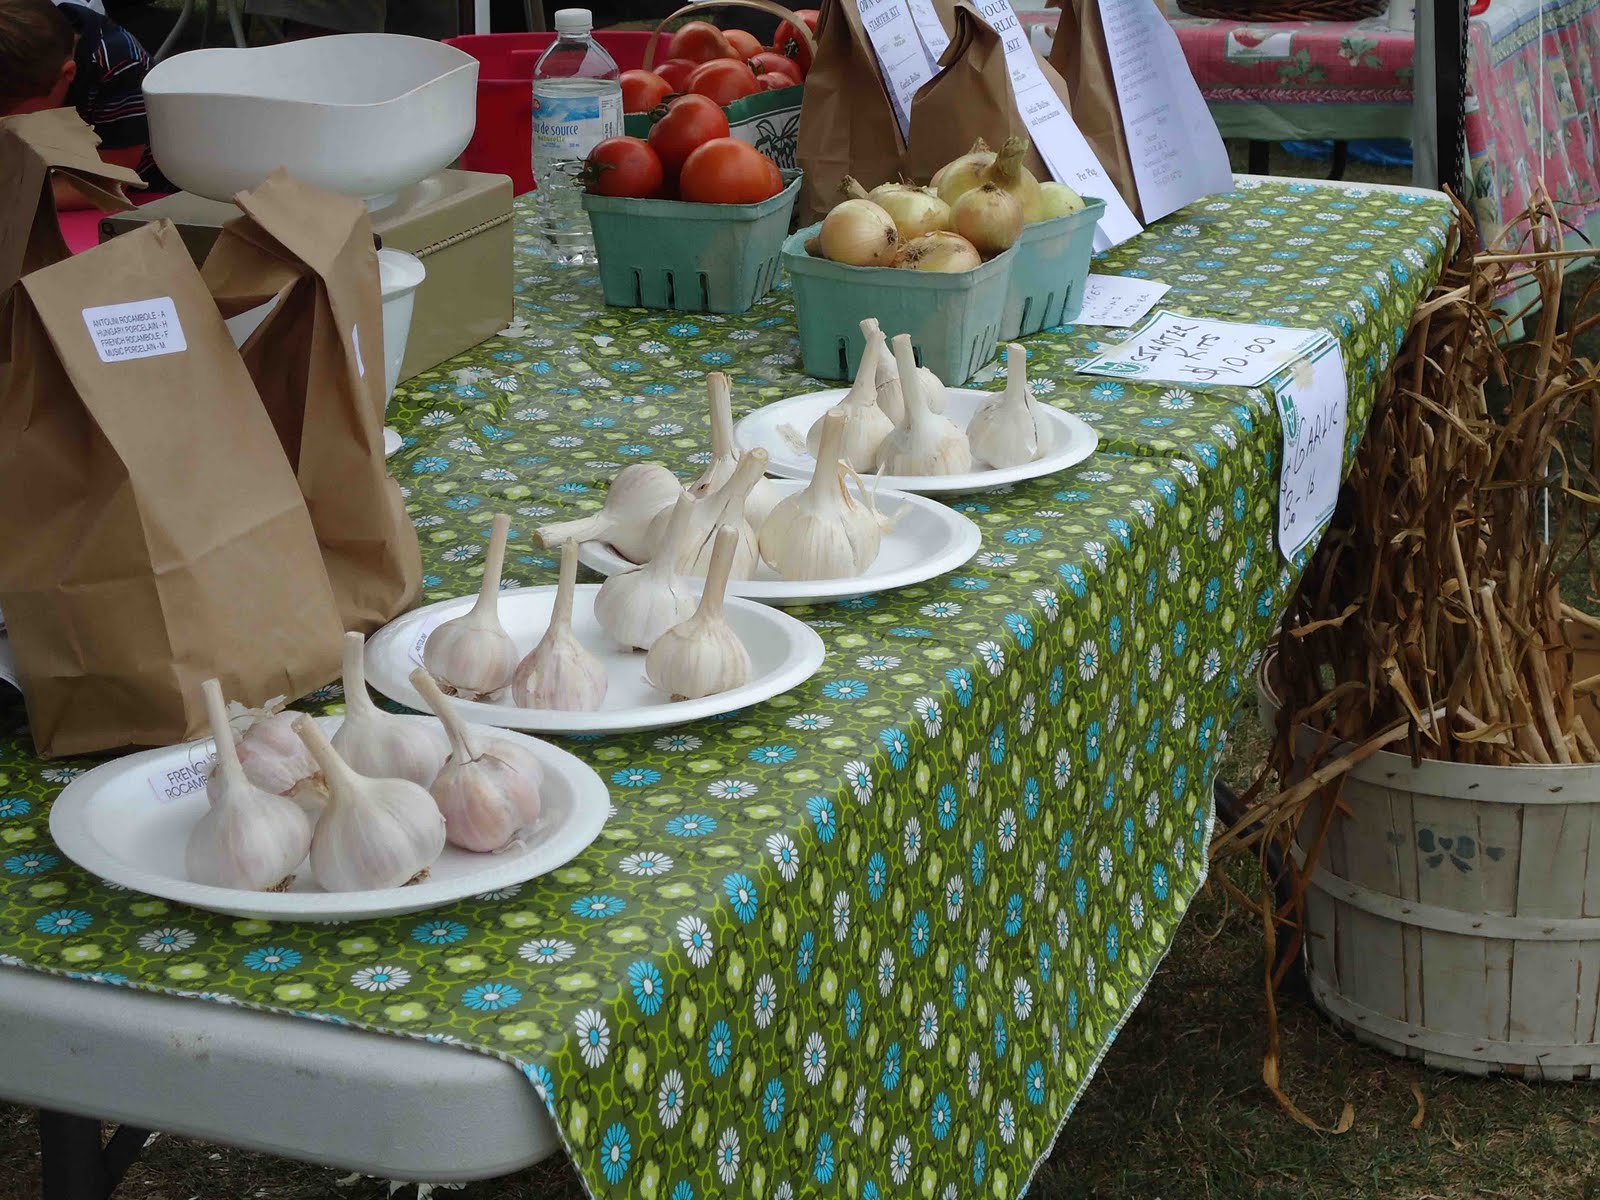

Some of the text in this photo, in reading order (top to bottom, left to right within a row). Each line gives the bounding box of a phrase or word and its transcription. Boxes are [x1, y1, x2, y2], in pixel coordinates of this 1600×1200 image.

[868, 5, 900, 30] STARTER KIT
[980, 0, 1008, 19] YOUR
[993, 15, 1018, 33] RLIC
[1006, 37, 1021, 51] KIT
[541, 121, 549, 135] de
[551, 124, 579, 136] source
[118, 311, 157, 324] ROCAMBOLE
[124, 322, 159, 334] PORCELAIN
[162, 320, 168, 328] H
[100, 337, 126, 347] FRENCH
[125, 332, 161, 344] ROCAMBOLE
[1130, 325, 1199, 363] STARTER
[104, 346, 125, 357] MUSIC
[124, 343, 156, 354] PORCELAIN
[1294, 402, 1338, 474] GARLIC
[165, 775, 208, 799] ROCAMB
